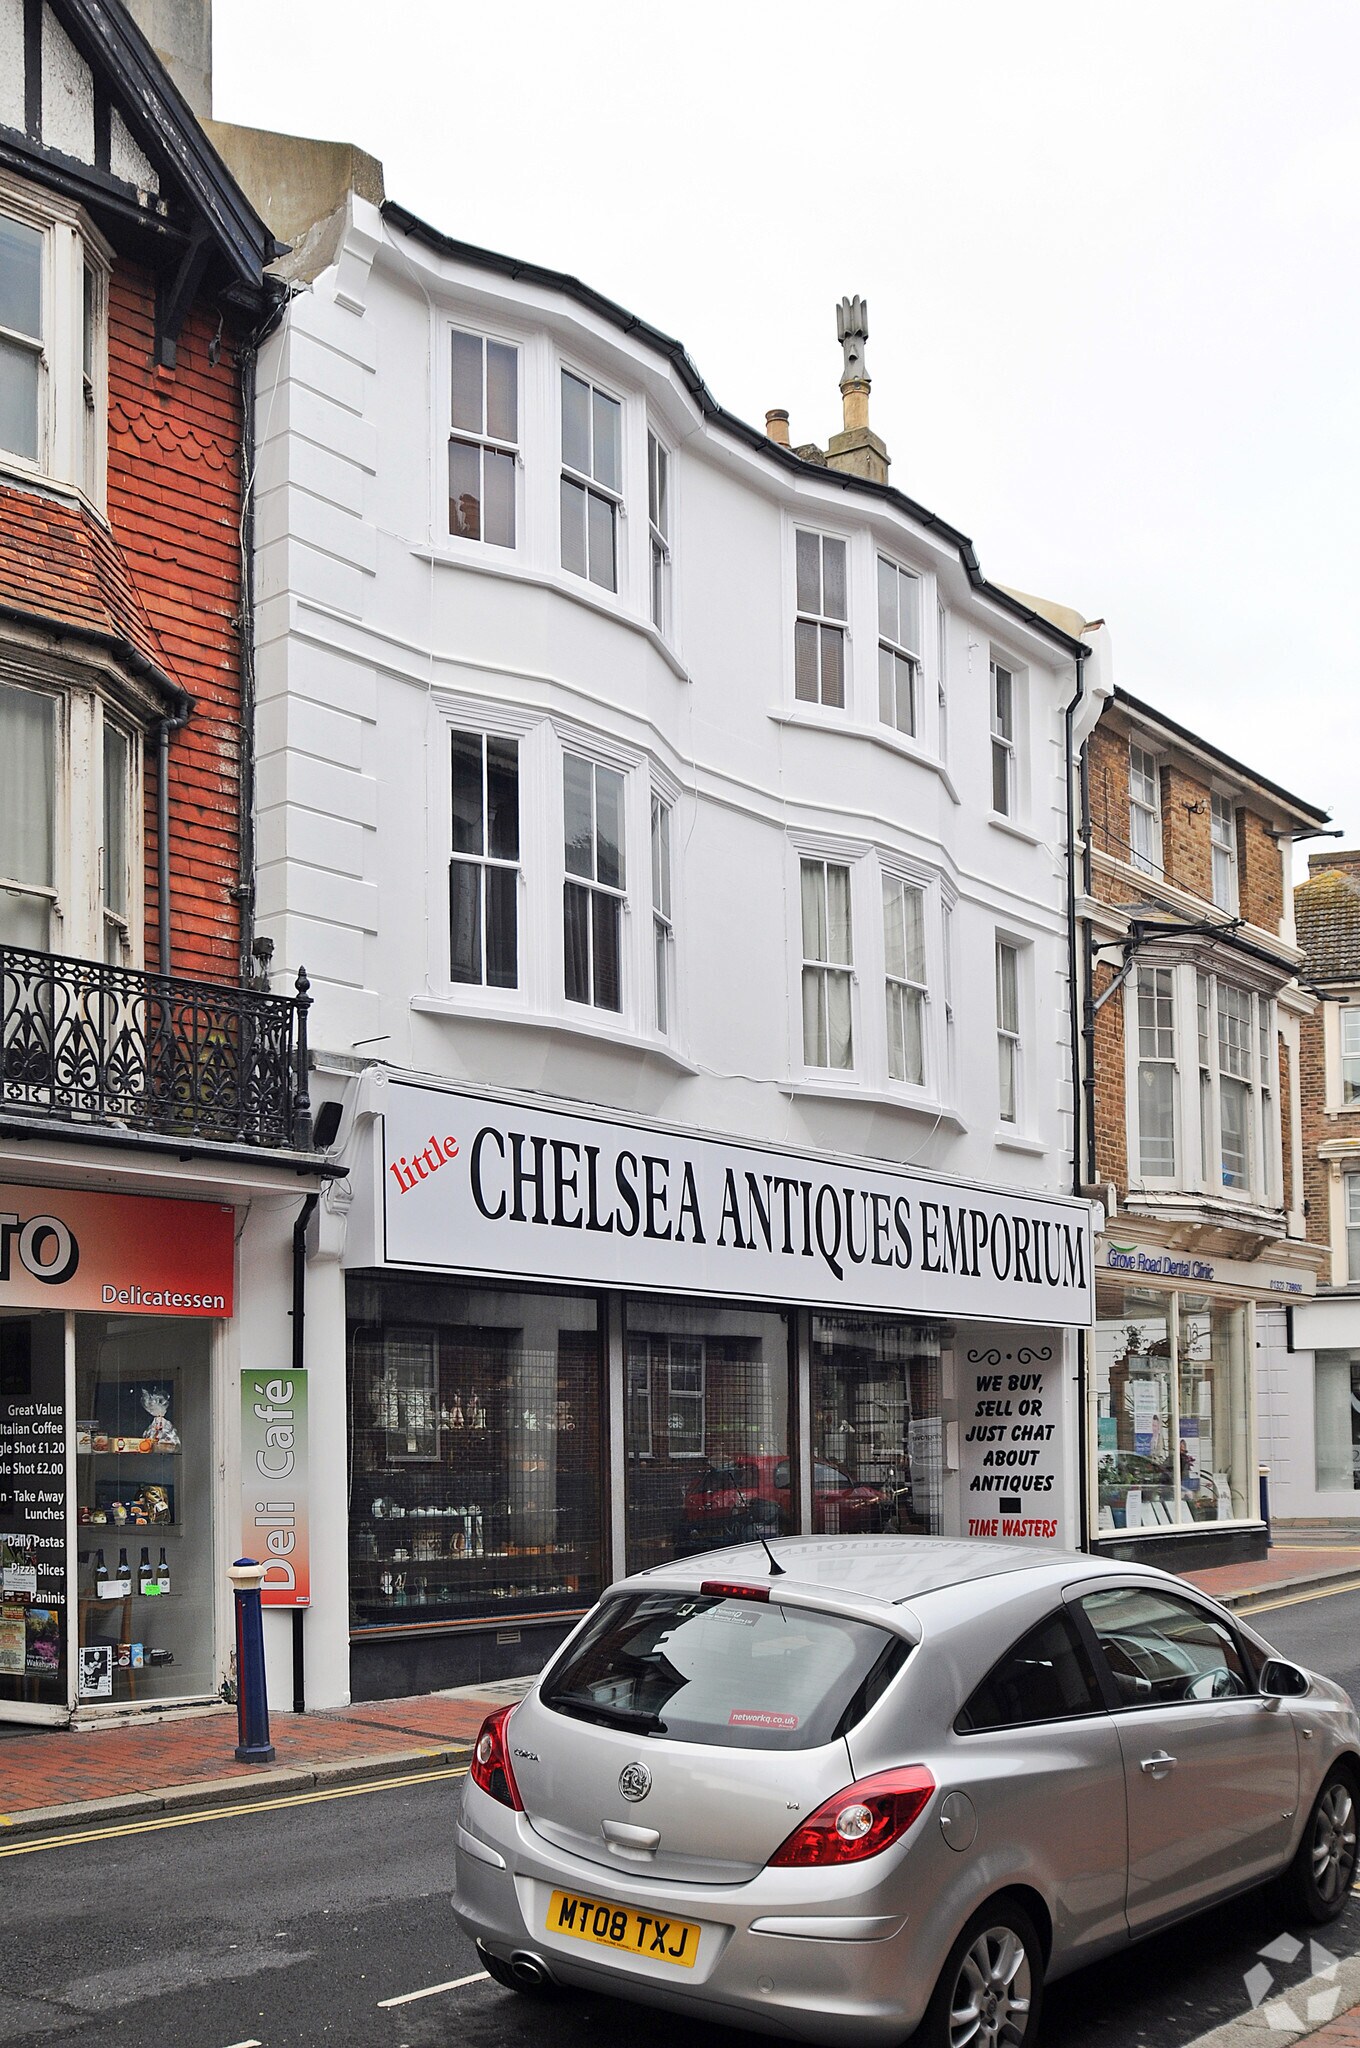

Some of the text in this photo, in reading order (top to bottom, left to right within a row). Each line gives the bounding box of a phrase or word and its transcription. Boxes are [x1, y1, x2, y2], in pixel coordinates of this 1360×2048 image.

[389, 1133, 460, 1195] little
[469, 1126, 1087, 1289] CHELSEA ANTIQUES EMPORIUM
[1107, 1249, 1215, 1280] Grove Road Dental Clinic
[102, 1284, 225, 1309] Delicatessen
[976, 1374, 1043, 1393] WE BUY,
[8, 1403, 63, 1416] Great Value
[975, 1399, 1043, 1417] SELL OR
[0, 1421, 63, 1435] Italian Coffee
[965, 1424, 1055, 1442] JUST CHAT
[14, 1441, 36, 1454] Shot
[38, 1442, 65, 1454] £1.20
[983, 1450, 1040, 1467] ABOUT
[13, 1462, 35, 1474] Shot
[37, 1462, 64, 1475] £2.00
[253, 1379, 296, 1591] Deli Café
[970, 1475, 1054, 1493] ANTIQUES
[13, 1490, 36, 1502] Take
[38, 1490, 64, 1505] Away
[25, 1507, 65, 1520] Lunches
[968, 1519, 1058, 1539] TIME WASTERS
[7, 1534, 65, 1550] Daily Pastas
[11, 1562, 65, 1576] Pizza Slices
[30, 1591, 66, 1605] Paninis
[732, 1712, 796, 1726] networkq.co.uk
[558, 1897, 689, 1957] MT08 TXJ
